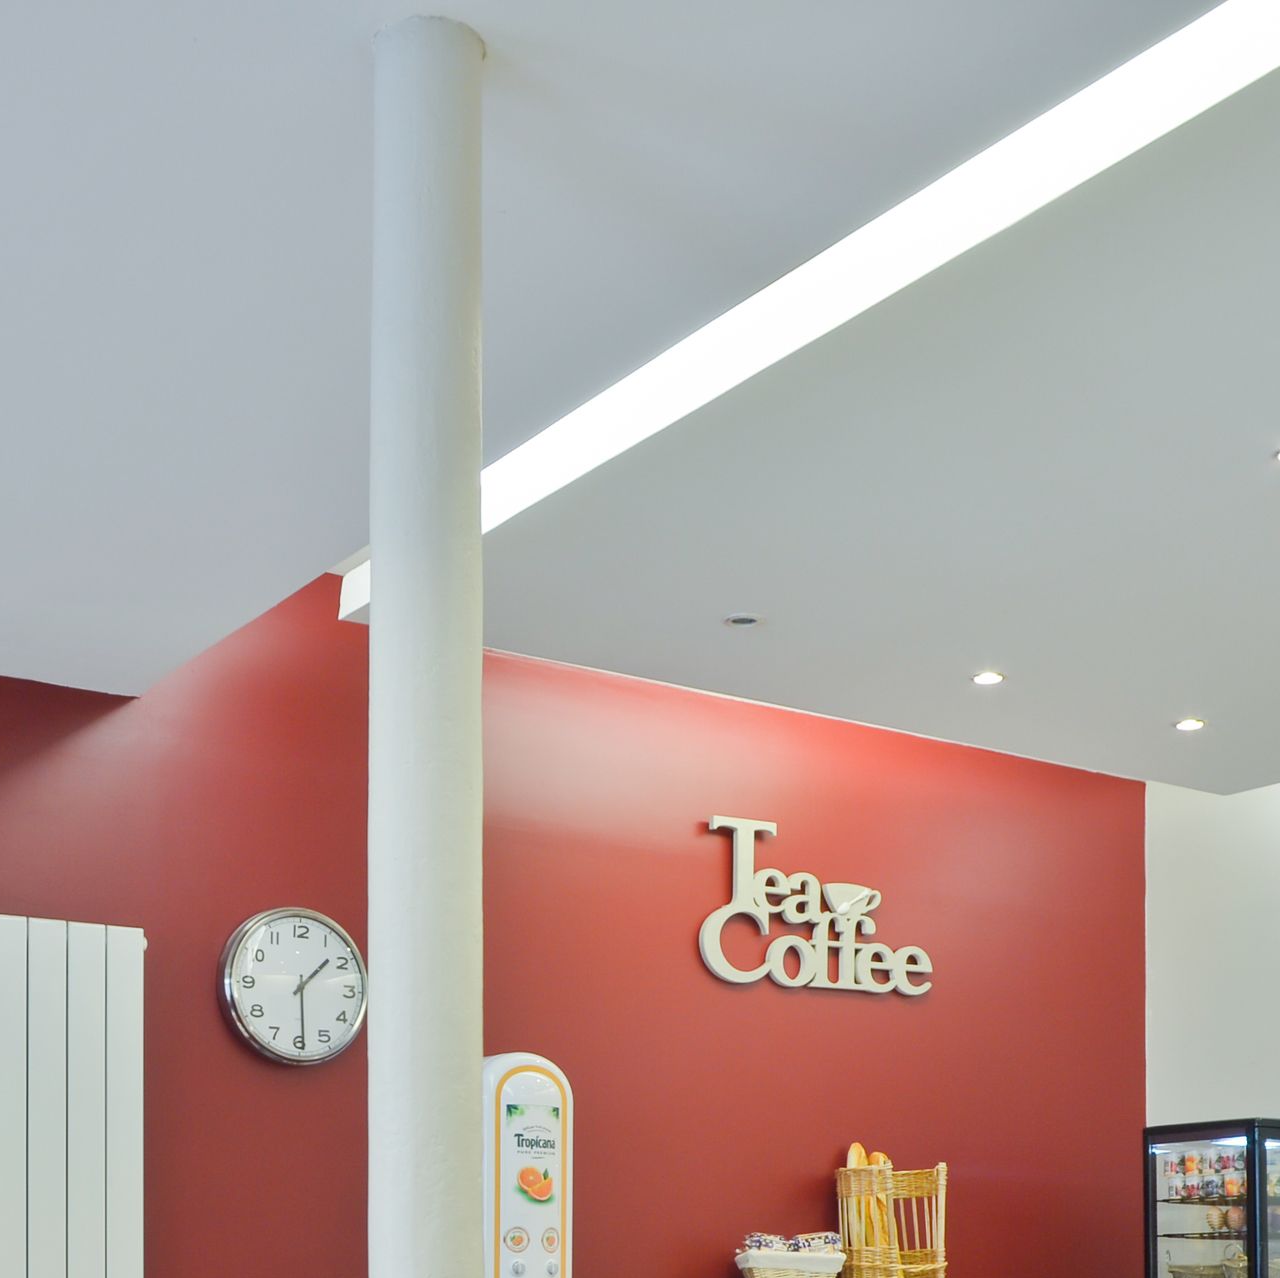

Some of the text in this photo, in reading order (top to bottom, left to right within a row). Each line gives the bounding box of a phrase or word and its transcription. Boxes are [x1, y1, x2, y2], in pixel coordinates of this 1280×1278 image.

[708, 815, 821, 925] Tea
[270, 931, 279, 945] 11
[293, 924, 309, 939] 12
[252, 949, 265, 963] 0
[699, 905, 933, 996] Coffee
[336, 957, 349, 970] 2
[242, 975, 255, 989] 9
[343, 985, 356, 999] 3
[250, 1004, 264, 1018] 8
[335, 1010, 348, 1024] 4
[268, 1026, 280, 1041] 7
[318, 1030, 331, 1043] 5
[513, 1133, 556, 1150] Tropicana
